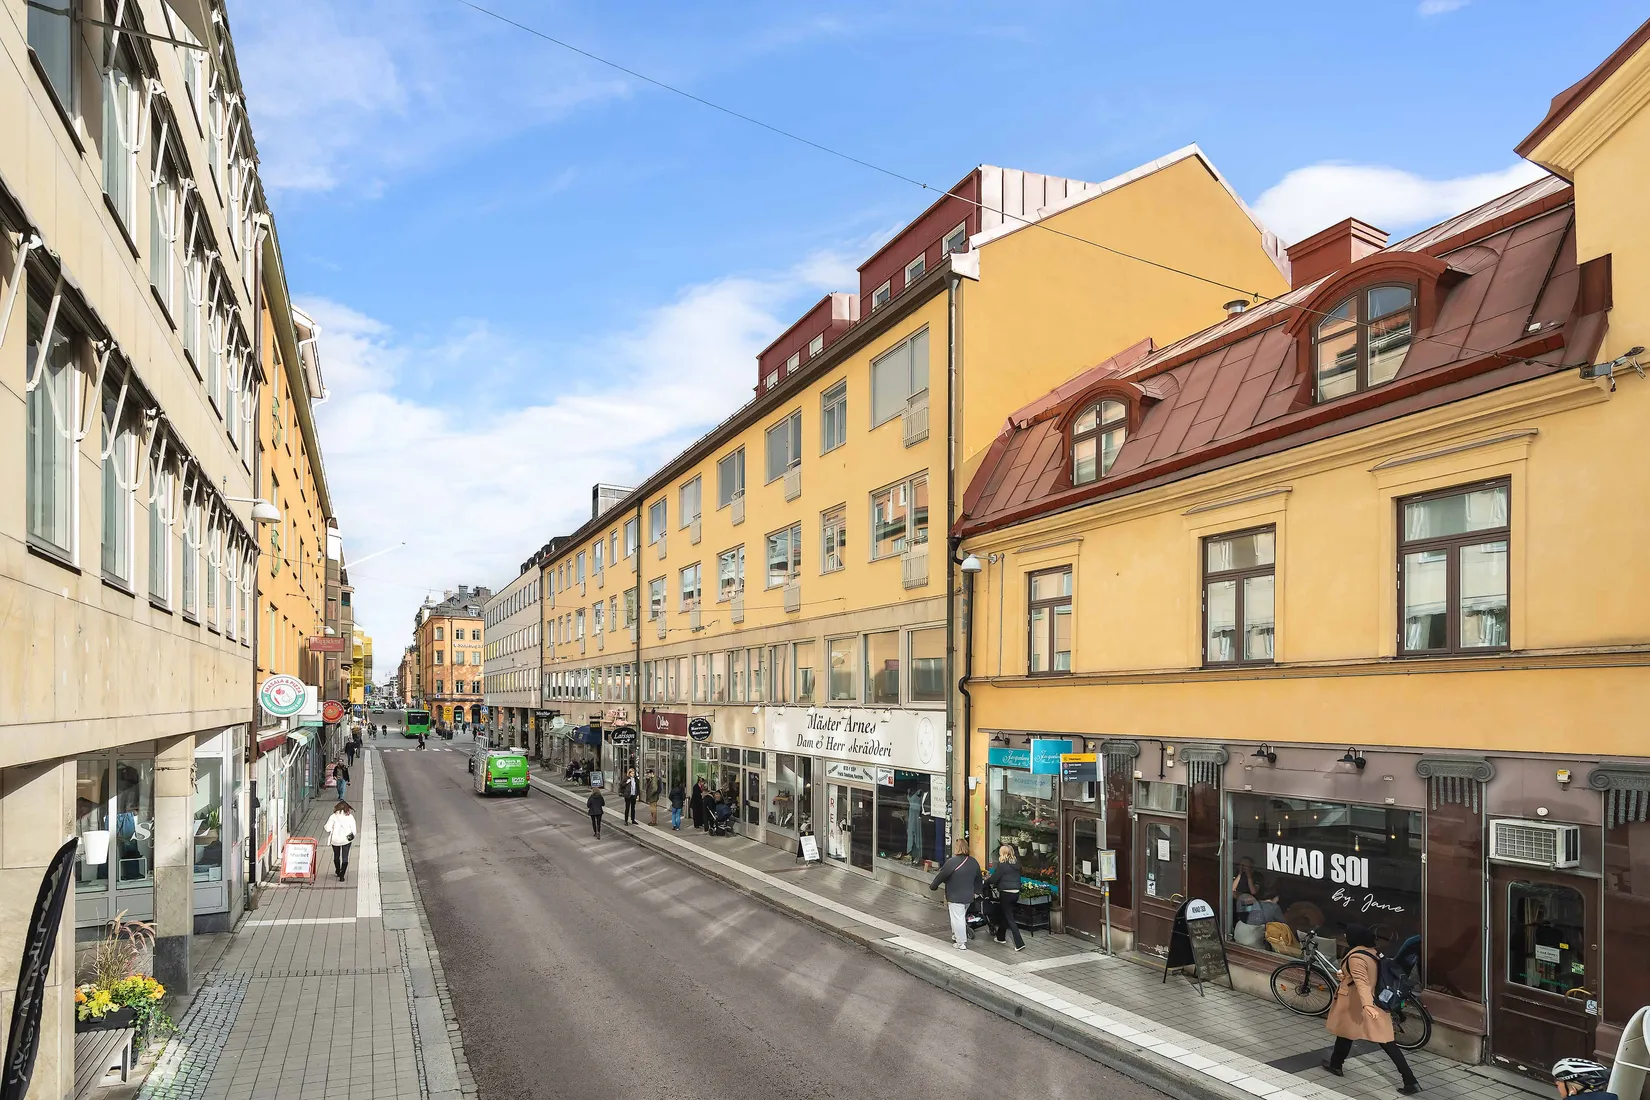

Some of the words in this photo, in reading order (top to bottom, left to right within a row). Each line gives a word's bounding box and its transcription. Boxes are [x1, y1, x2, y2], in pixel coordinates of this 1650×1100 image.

[265, 679, 284, 693] MASALA
[290, 681, 302, 693] PIZZA
[807, 713, 842, 731] Mäster
[843, 713, 877, 734] Arnes
[796, 734, 814, 749] Dam
[815, 735, 824, 749] &
[825, 736, 846, 752] Herr
[848, 738, 893, 757] skrädderi
[1266, 842, 1324, 879] KHAO
[1330, 853, 1369, 888] SOI
[1331, 888, 1355, 907] By
[1361, 893, 1405, 912] Jane
